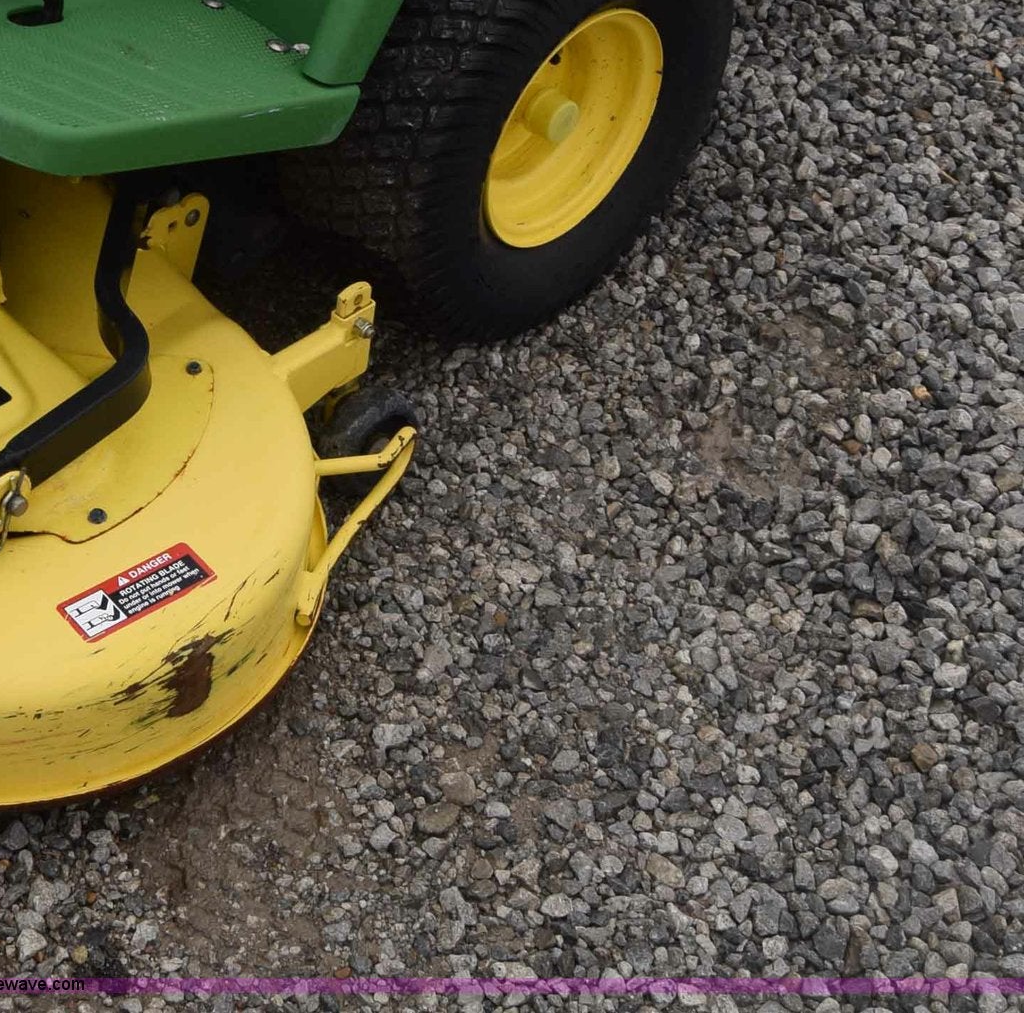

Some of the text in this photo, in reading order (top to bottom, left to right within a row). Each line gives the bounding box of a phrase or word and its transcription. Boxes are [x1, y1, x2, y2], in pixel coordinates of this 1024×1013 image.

[119, 560, 185, 597] ROTATING BLADE
[128, 553, 172, 579] DANGER
[129, 591, 141, 600] not
[139, 586, 151, 595] put
[150, 576, 170, 588] hands
[176, 566, 190, 575] feet
[123, 598, 142, 609] under
[149, 587, 163, 596] into
[162, 577, 182, 589] mower
[182, 568, 200, 579] when
[127, 601, 150, 614] engine
[156, 585, 181, 600] running
